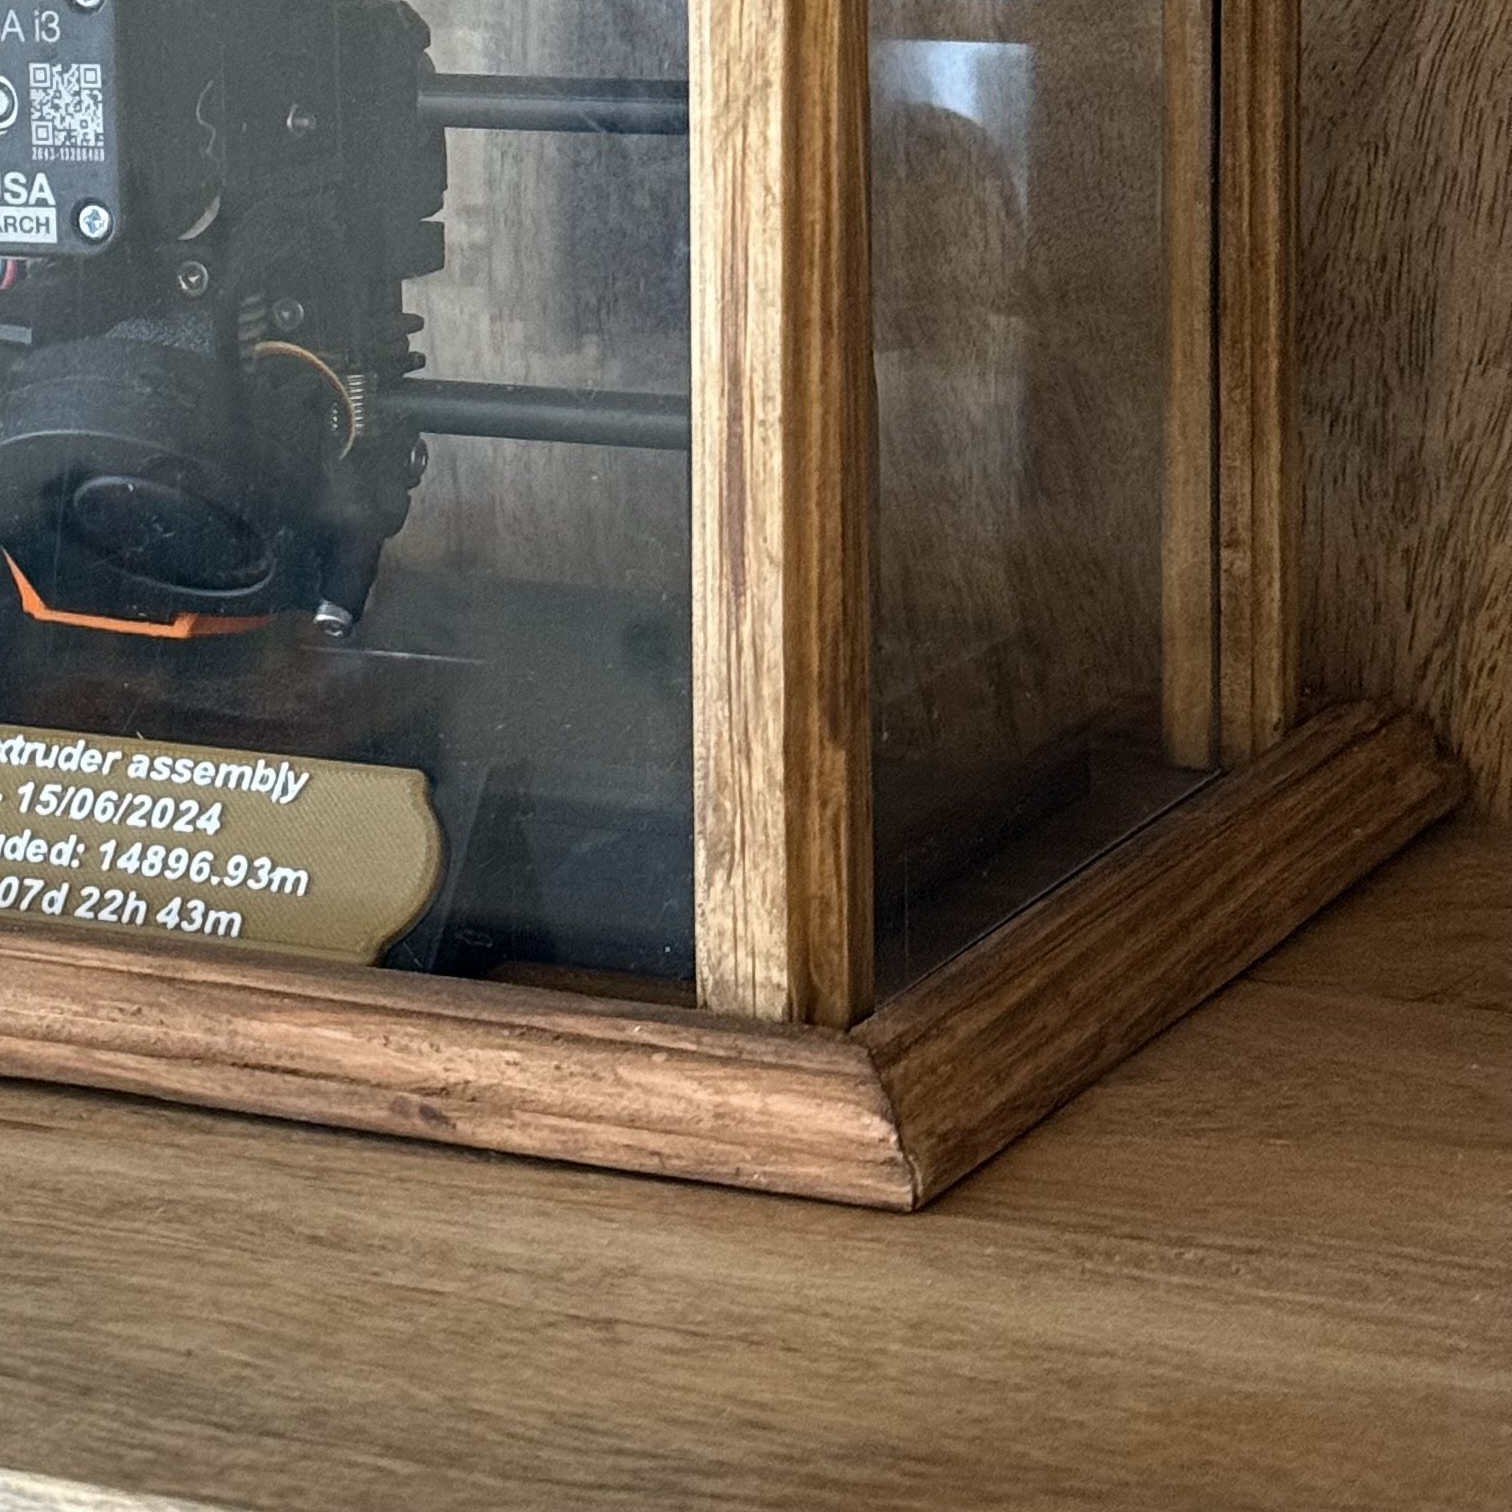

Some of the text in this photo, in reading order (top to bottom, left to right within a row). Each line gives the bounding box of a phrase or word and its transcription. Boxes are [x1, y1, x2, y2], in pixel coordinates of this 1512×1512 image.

[35, 10, 61, 43] i3
[127, 753, 309, 804] assembly
[17, 781, 222, 836] 15/06/2024
[99, 839, 308, 897] 14896.93m
[74, 886, 147, 926] 22h
[156, 896, 243, 938] 43m
